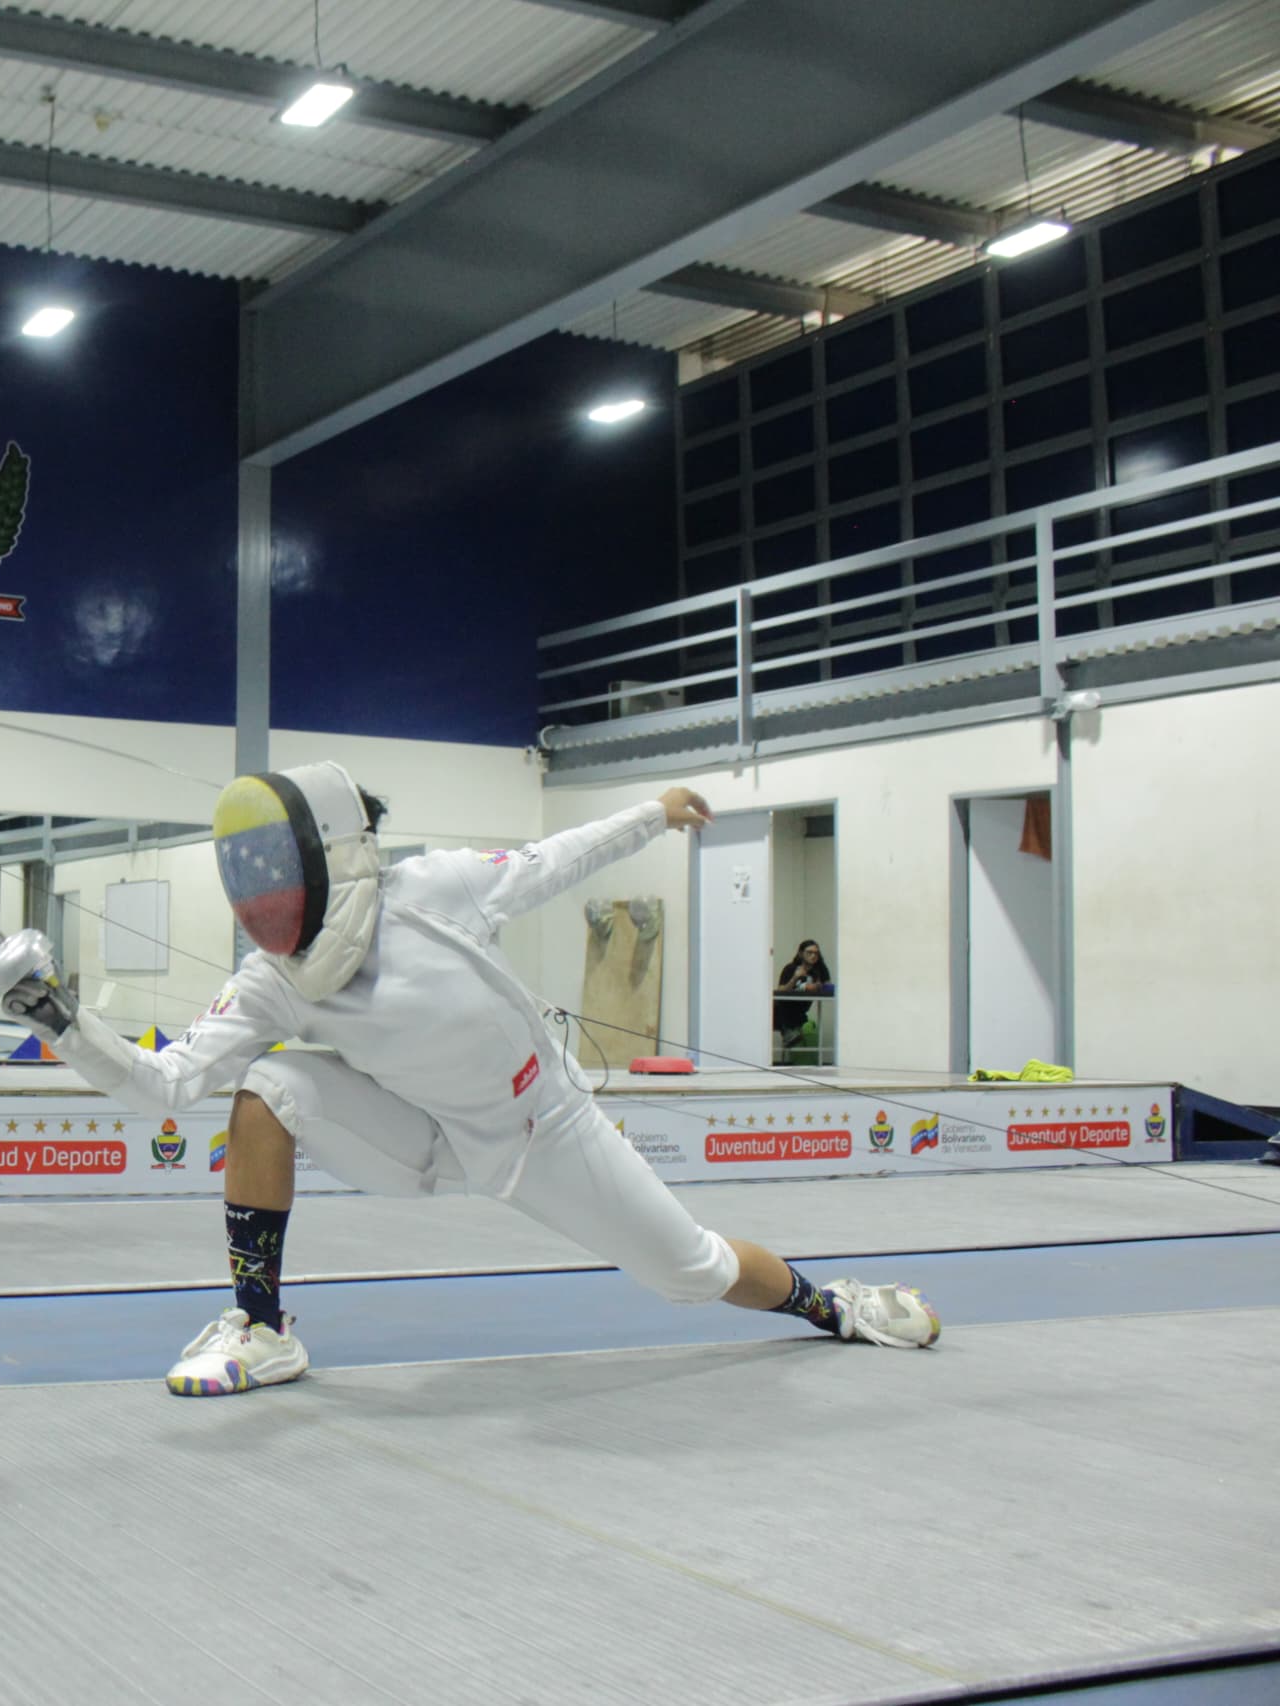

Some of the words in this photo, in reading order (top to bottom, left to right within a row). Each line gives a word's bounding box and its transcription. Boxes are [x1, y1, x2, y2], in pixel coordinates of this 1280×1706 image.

[707, 1137, 776, 1156] Juventud
[779, 1140, 788, 1158] y
[792, 1135, 849, 1156] Deporte
[941, 1133, 987, 1144] Bolivariano
[1009, 1127, 1067, 1145] Juventud
[1069, 1131, 1077, 1146] y
[1080, 1125, 1129, 1145] Deporte
[24, 1150, 37, 1172] y
[42, 1145, 122, 1171] Deporte
